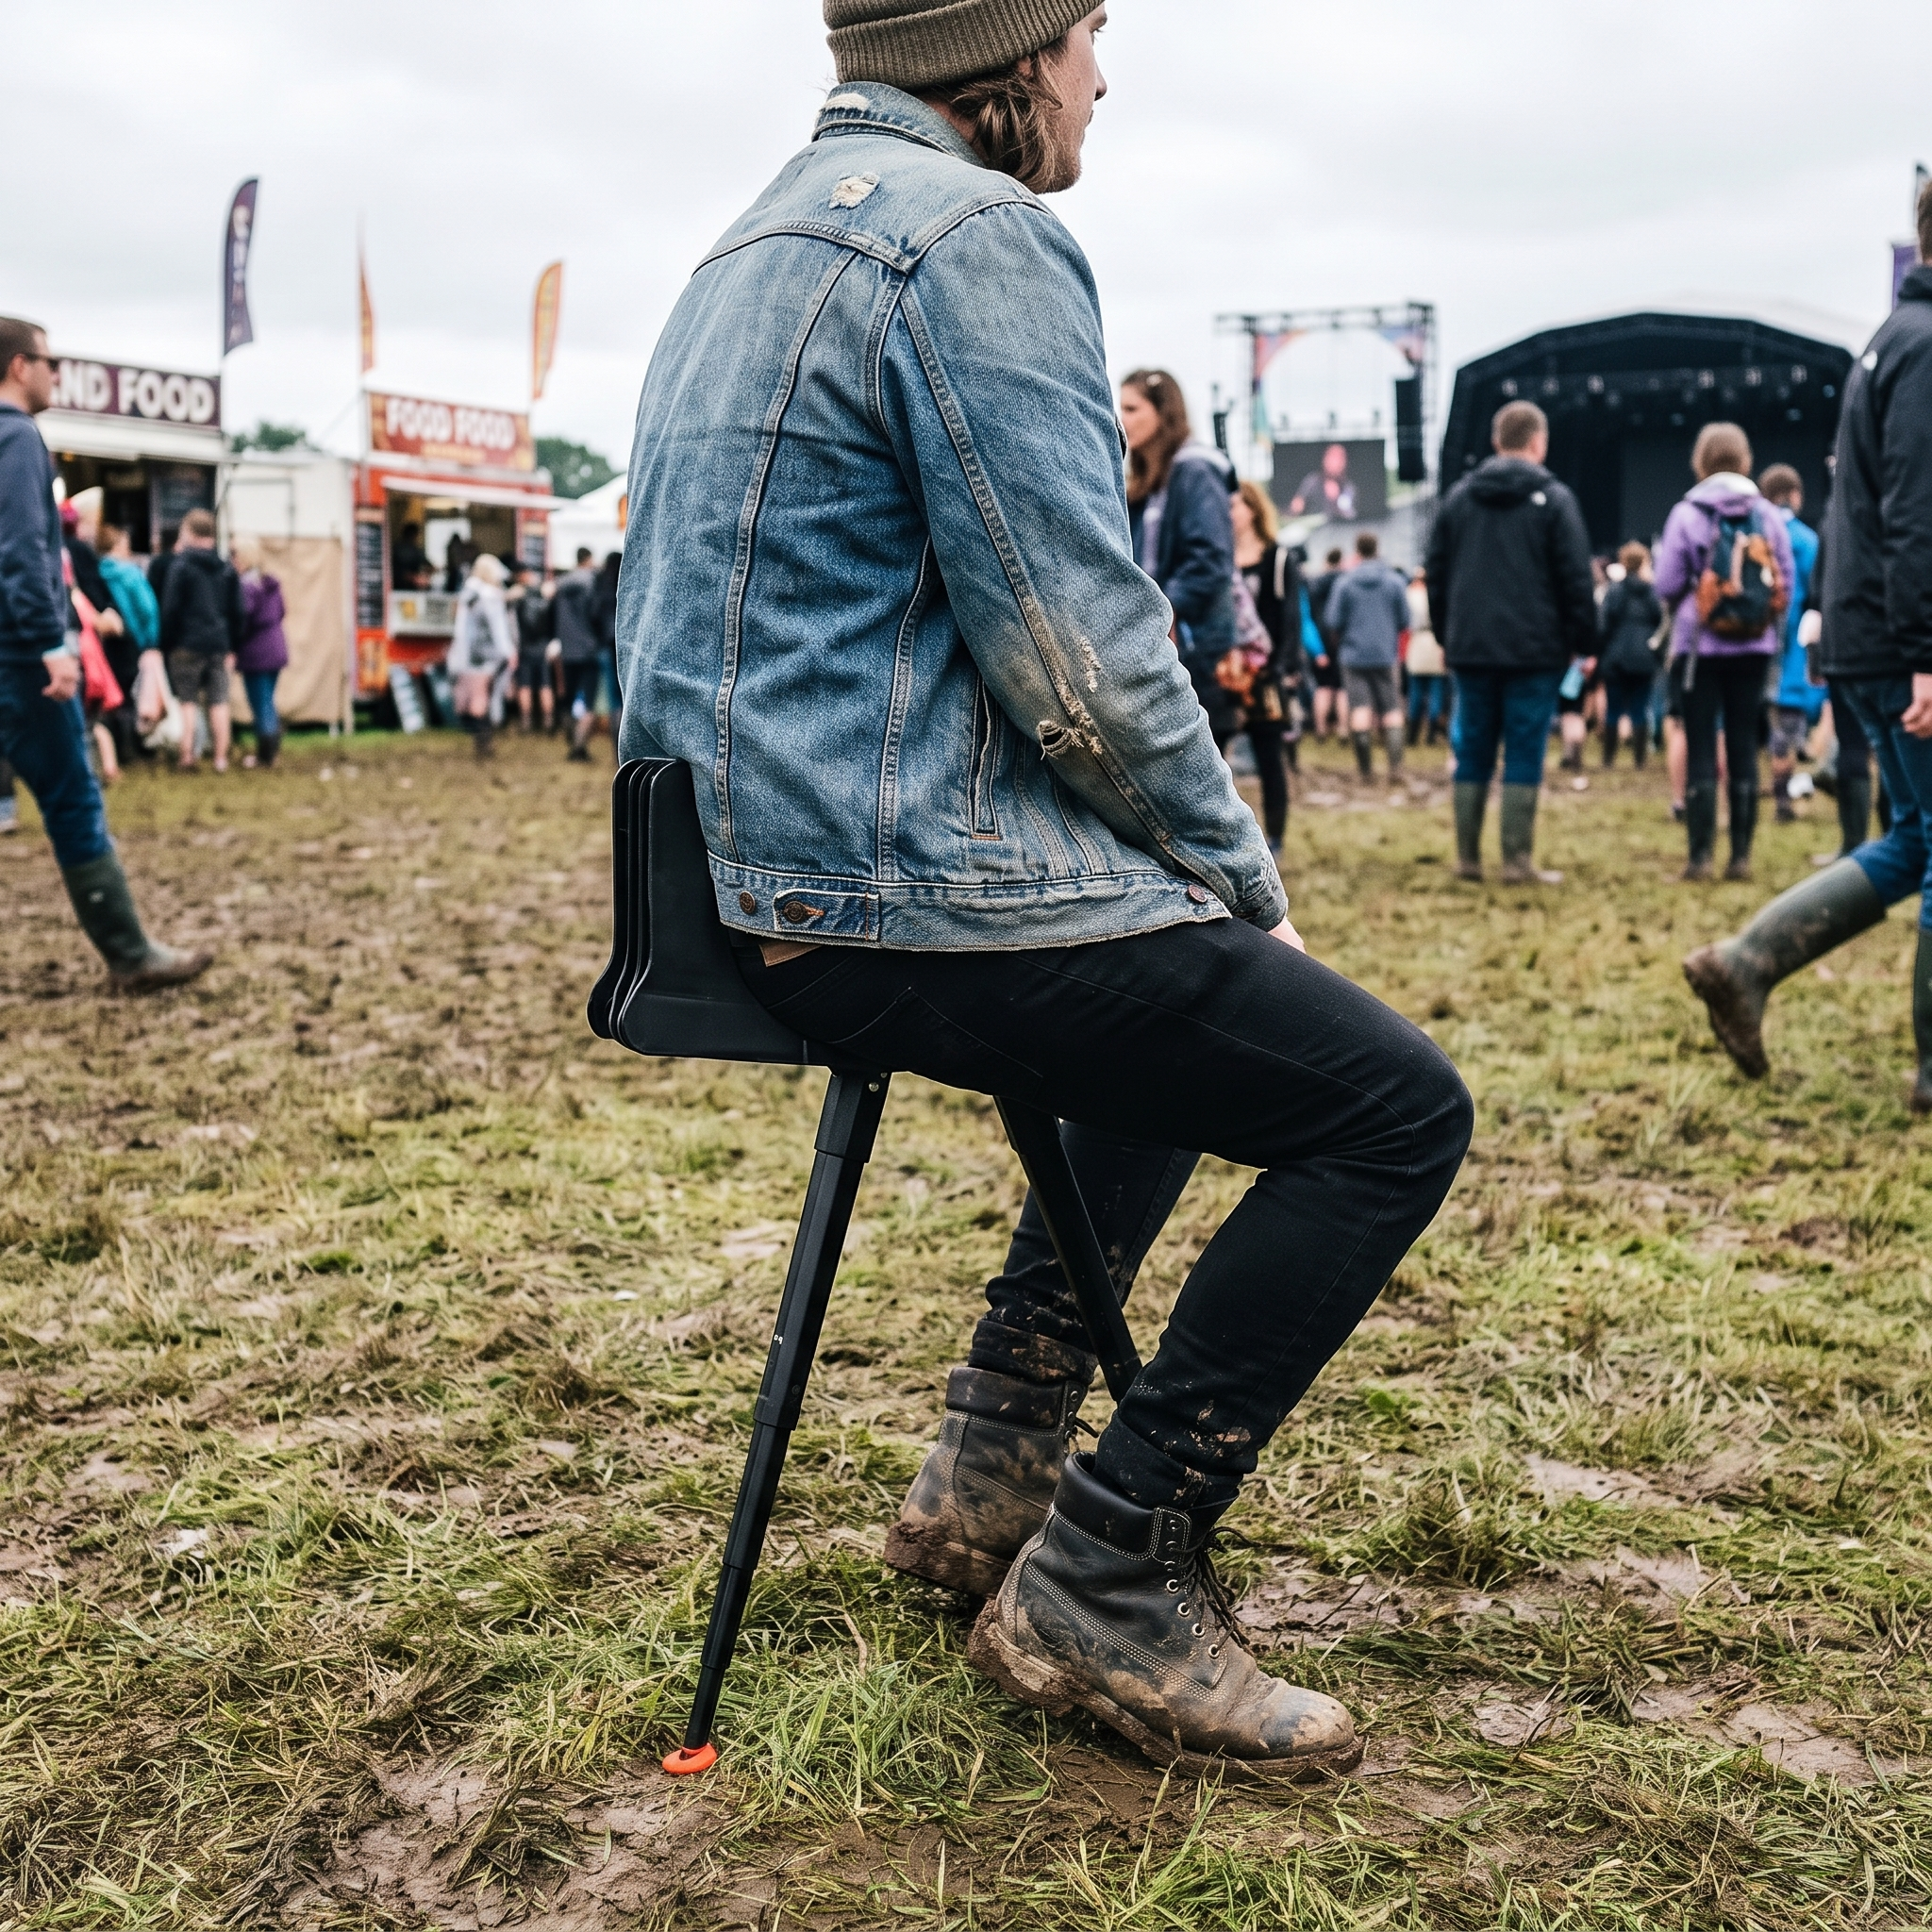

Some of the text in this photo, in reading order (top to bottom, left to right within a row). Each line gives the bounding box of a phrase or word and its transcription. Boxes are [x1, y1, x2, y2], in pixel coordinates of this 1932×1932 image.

[117, 367, 216, 424] FOOD
[386, 397, 516, 450] FOOD FOOD
